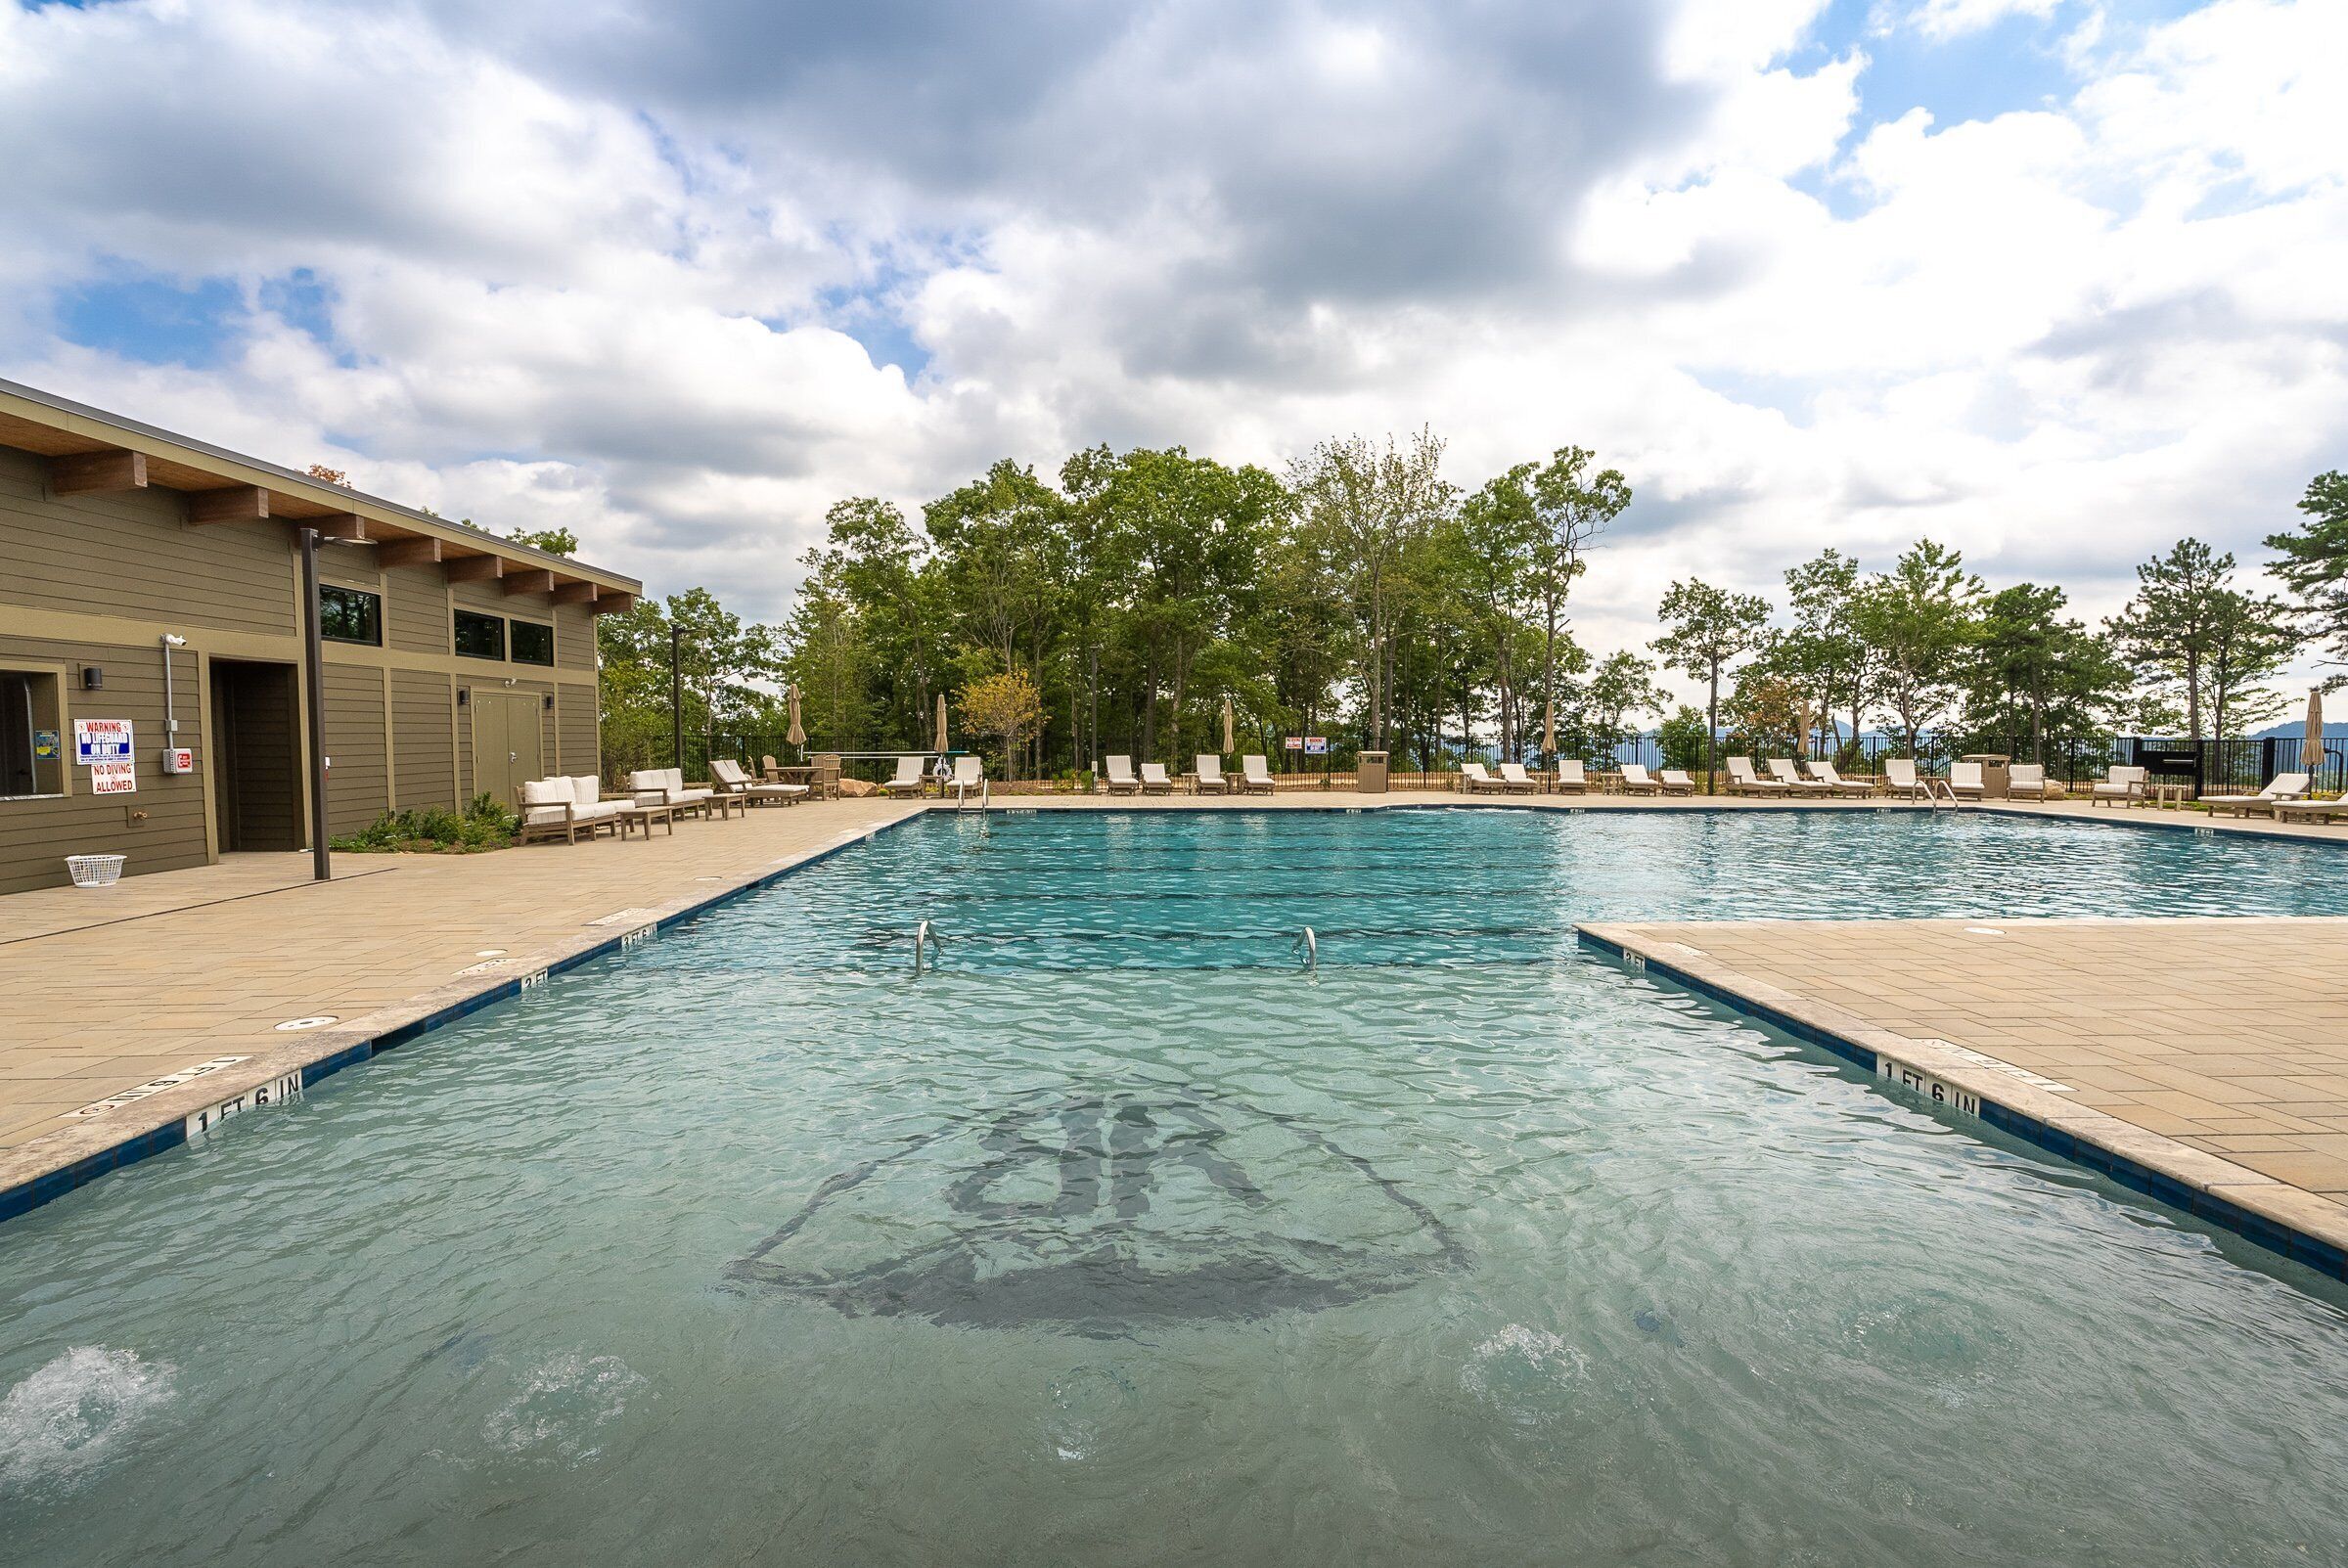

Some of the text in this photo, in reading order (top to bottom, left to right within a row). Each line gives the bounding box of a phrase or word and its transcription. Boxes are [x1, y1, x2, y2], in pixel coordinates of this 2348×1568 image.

[85, 722, 121, 733] WARNING
[81, 733, 128, 744] NO LIFEGUARD
[90, 743, 120, 755] ON DUTY
[94, 763, 132, 776] NO DIVING
[96, 780, 133, 792] ALLOWED
[1885, 1061, 1975, 1114] 1 FT 6 IN
[198, 1074, 299, 1134] 1 FT 6 IN
